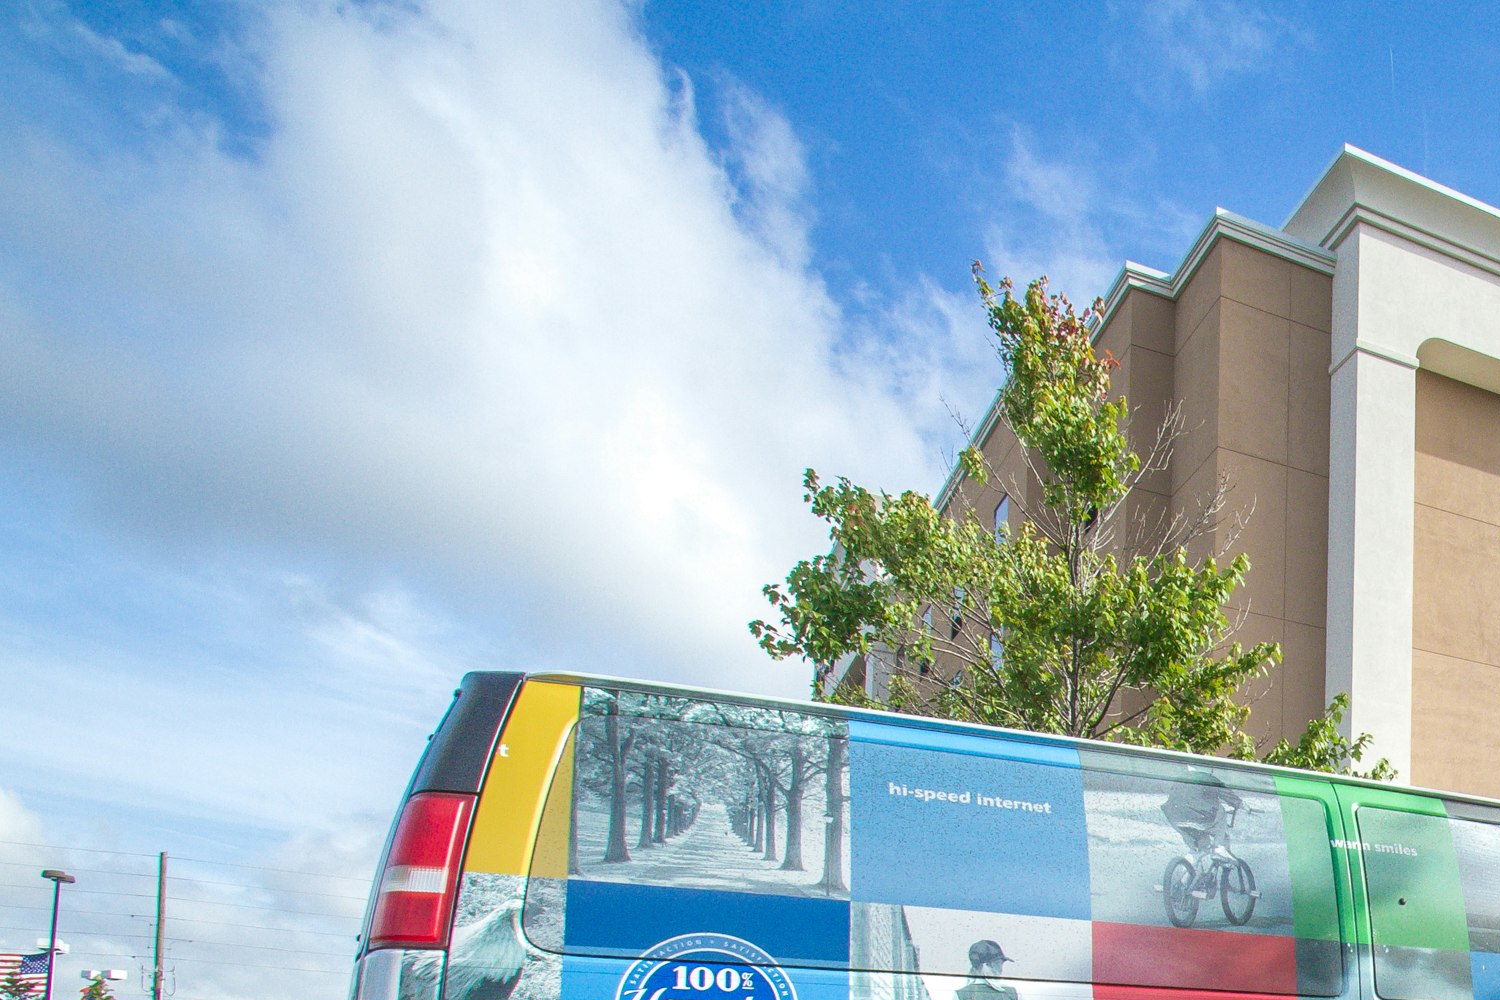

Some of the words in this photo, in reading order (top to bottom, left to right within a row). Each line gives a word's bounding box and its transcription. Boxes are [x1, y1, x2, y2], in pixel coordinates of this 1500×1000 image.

[888, 782, 971, 804] hi-speed
[976, 793, 1052, 814] internet
[1330, 839, 1370, 851] warm
[1374, 843, 1418, 857] smiles
[672, 965, 755, 992] 100%
